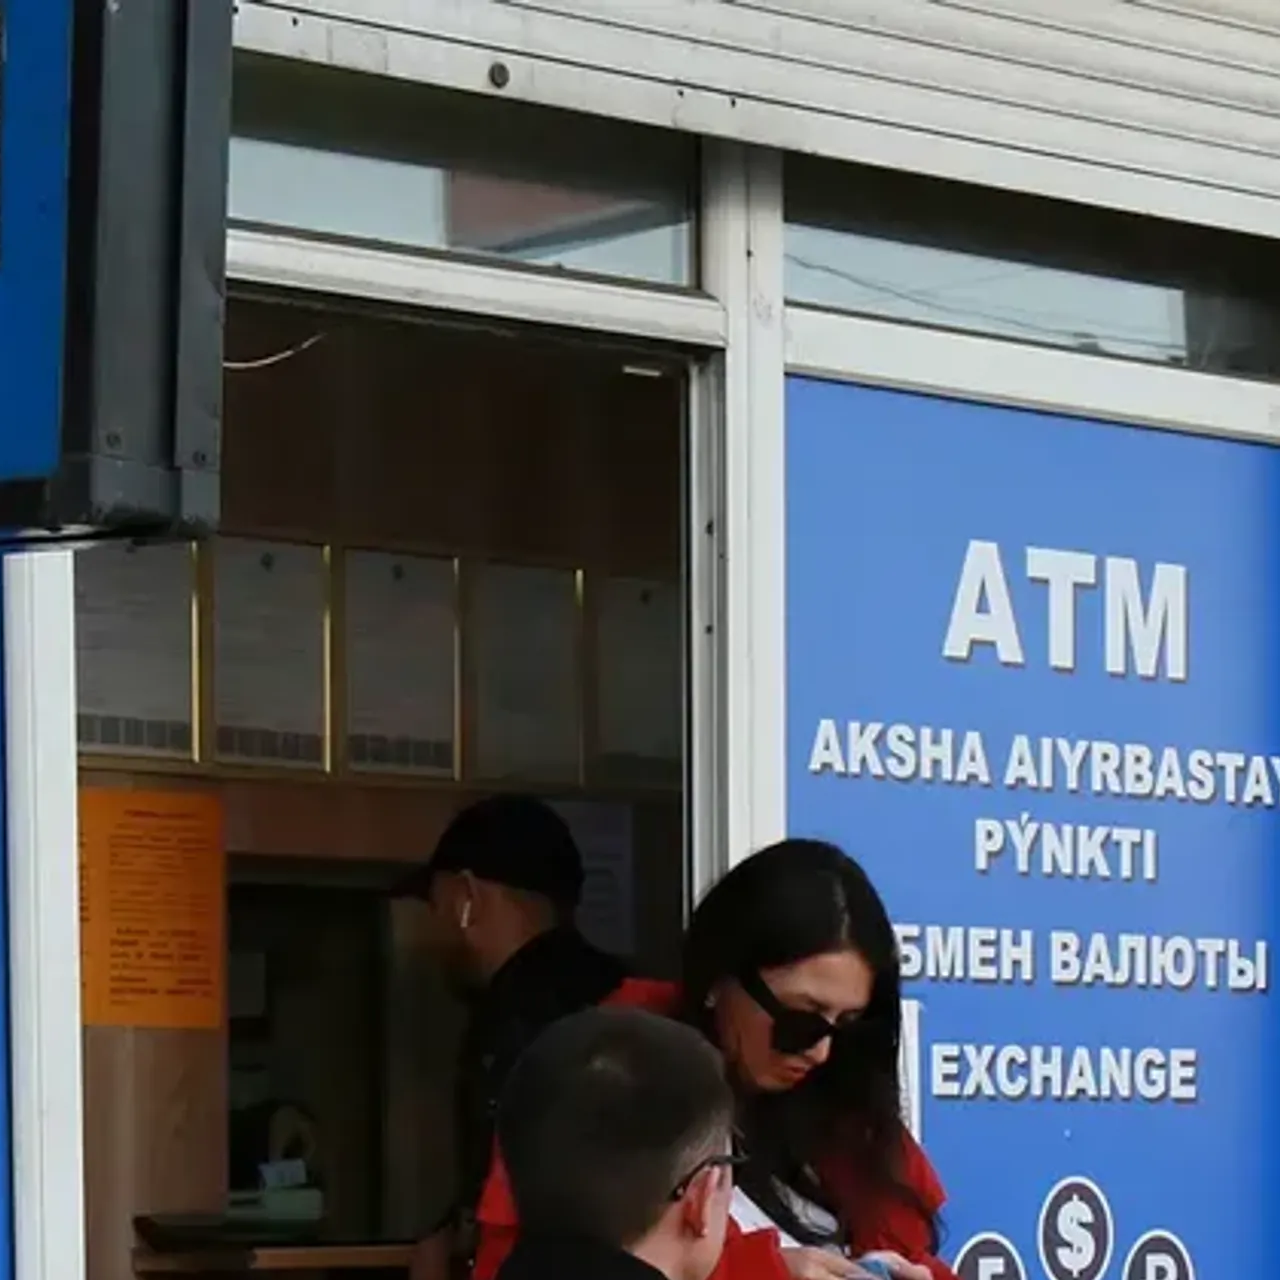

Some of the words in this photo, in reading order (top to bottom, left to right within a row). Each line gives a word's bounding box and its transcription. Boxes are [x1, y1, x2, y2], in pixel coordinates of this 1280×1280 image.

[942, 539, 1187, 682] ATM
[808, 719, 991, 786] AKSHA
[1050, 930, 1268, 991] ВАЛЮТЫ
[930, 1043, 1198, 1099] EXCHANGE
